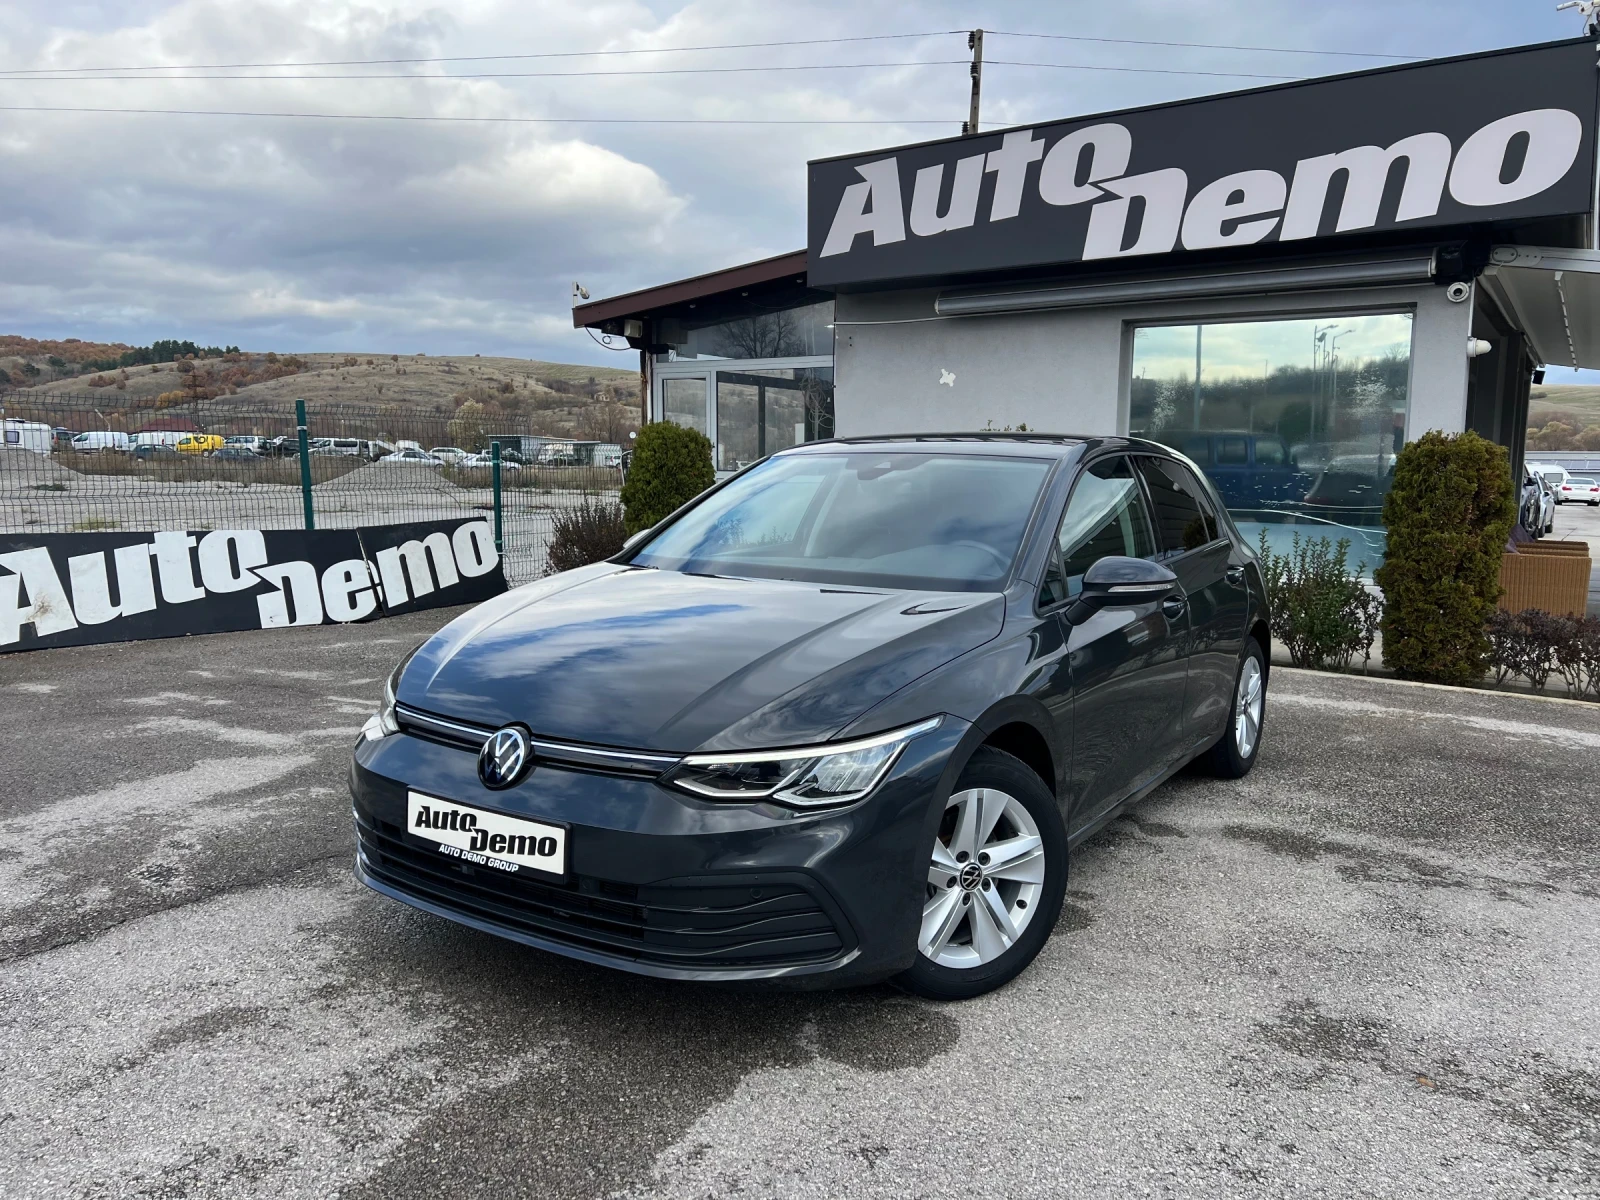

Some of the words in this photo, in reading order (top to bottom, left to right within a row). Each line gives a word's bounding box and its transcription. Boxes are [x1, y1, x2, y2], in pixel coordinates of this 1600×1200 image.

[819, 122, 1133, 258] Auto
[1081, 108, 1583, 261] Demo
[0, 529, 269, 646] Auto
[252, 520, 500, 629] Demo
[414, 805, 478, 833] Auto
[469, 827, 558, 857] Demo
[439, 844, 461, 857] AUTO
[461, 850, 487, 865] DEMO
[487, 857, 519, 873] GROUP
